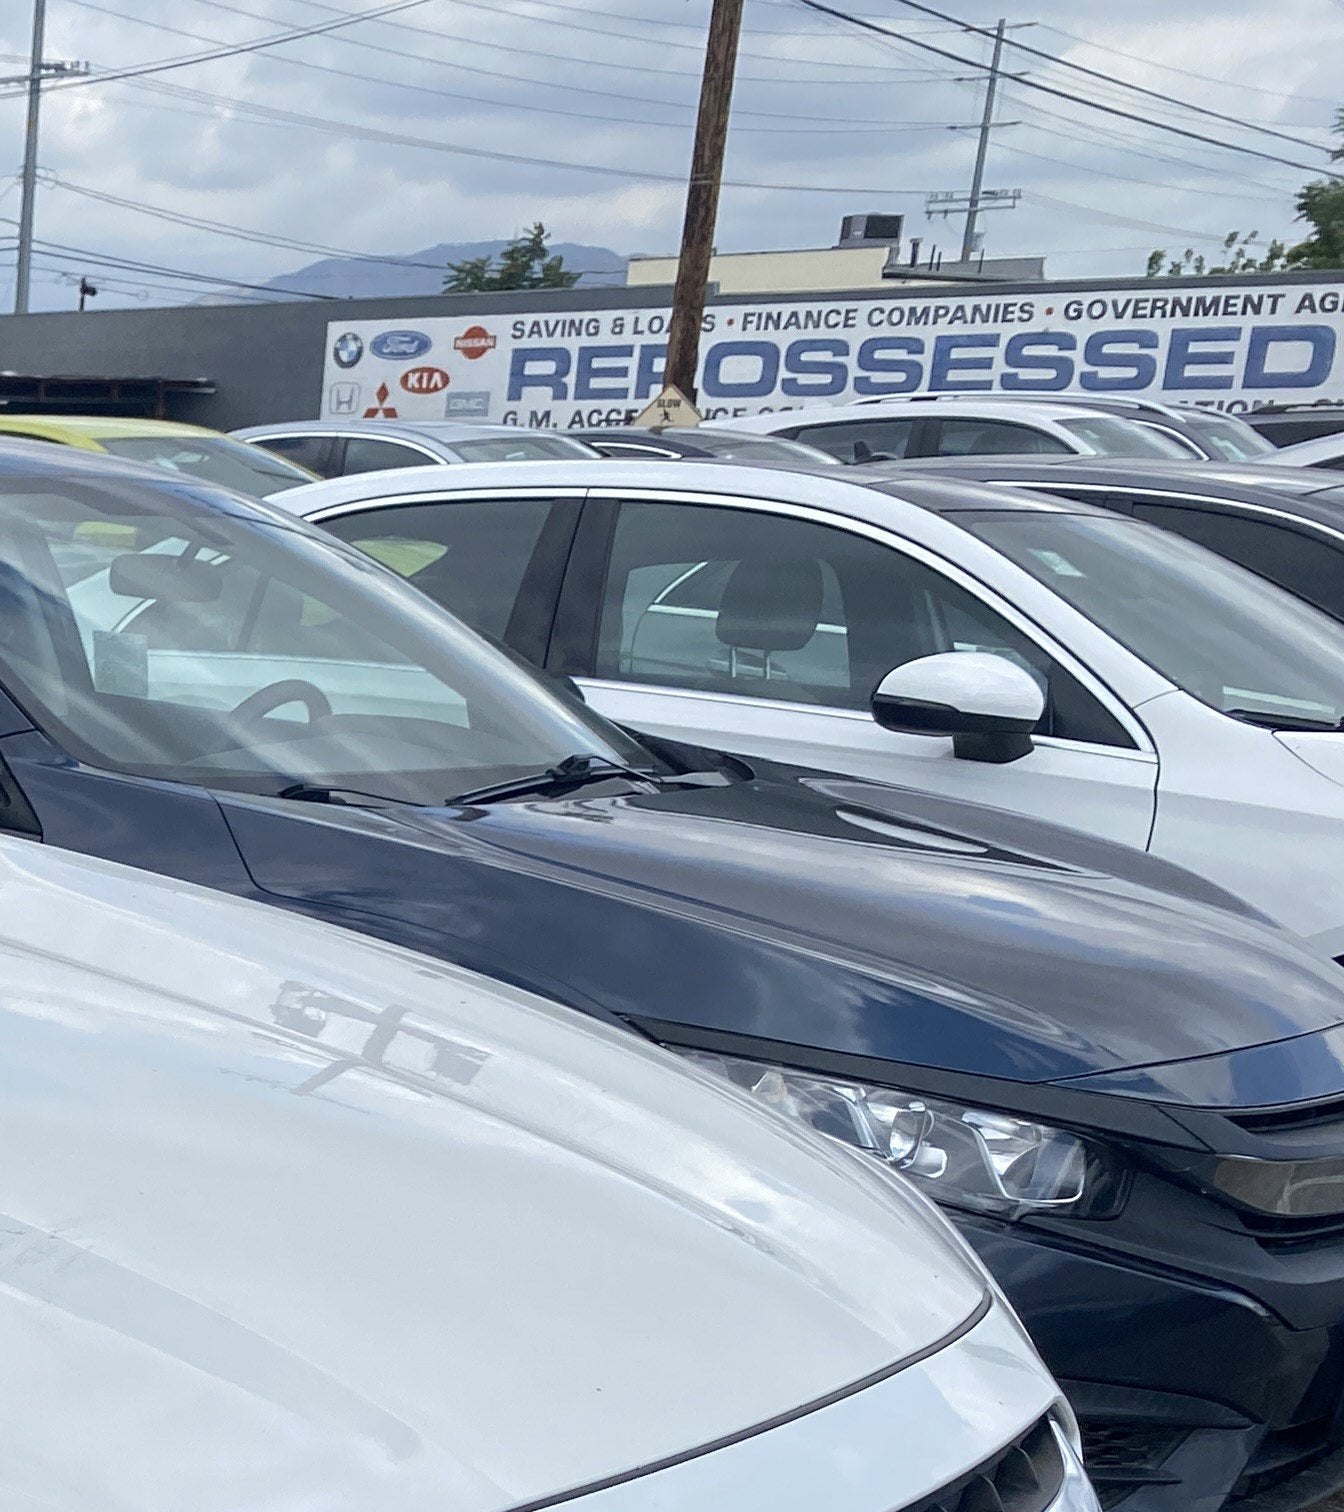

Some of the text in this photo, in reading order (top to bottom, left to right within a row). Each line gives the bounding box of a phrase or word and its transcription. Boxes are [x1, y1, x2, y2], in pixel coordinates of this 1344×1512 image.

[511, 292, 1344, 339] SAVING & LOS FINANCE COMPANIES GOVERNMENT AG
[408, 372, 443, 389] KIA
[657, 398, 681, 408] SLOW
